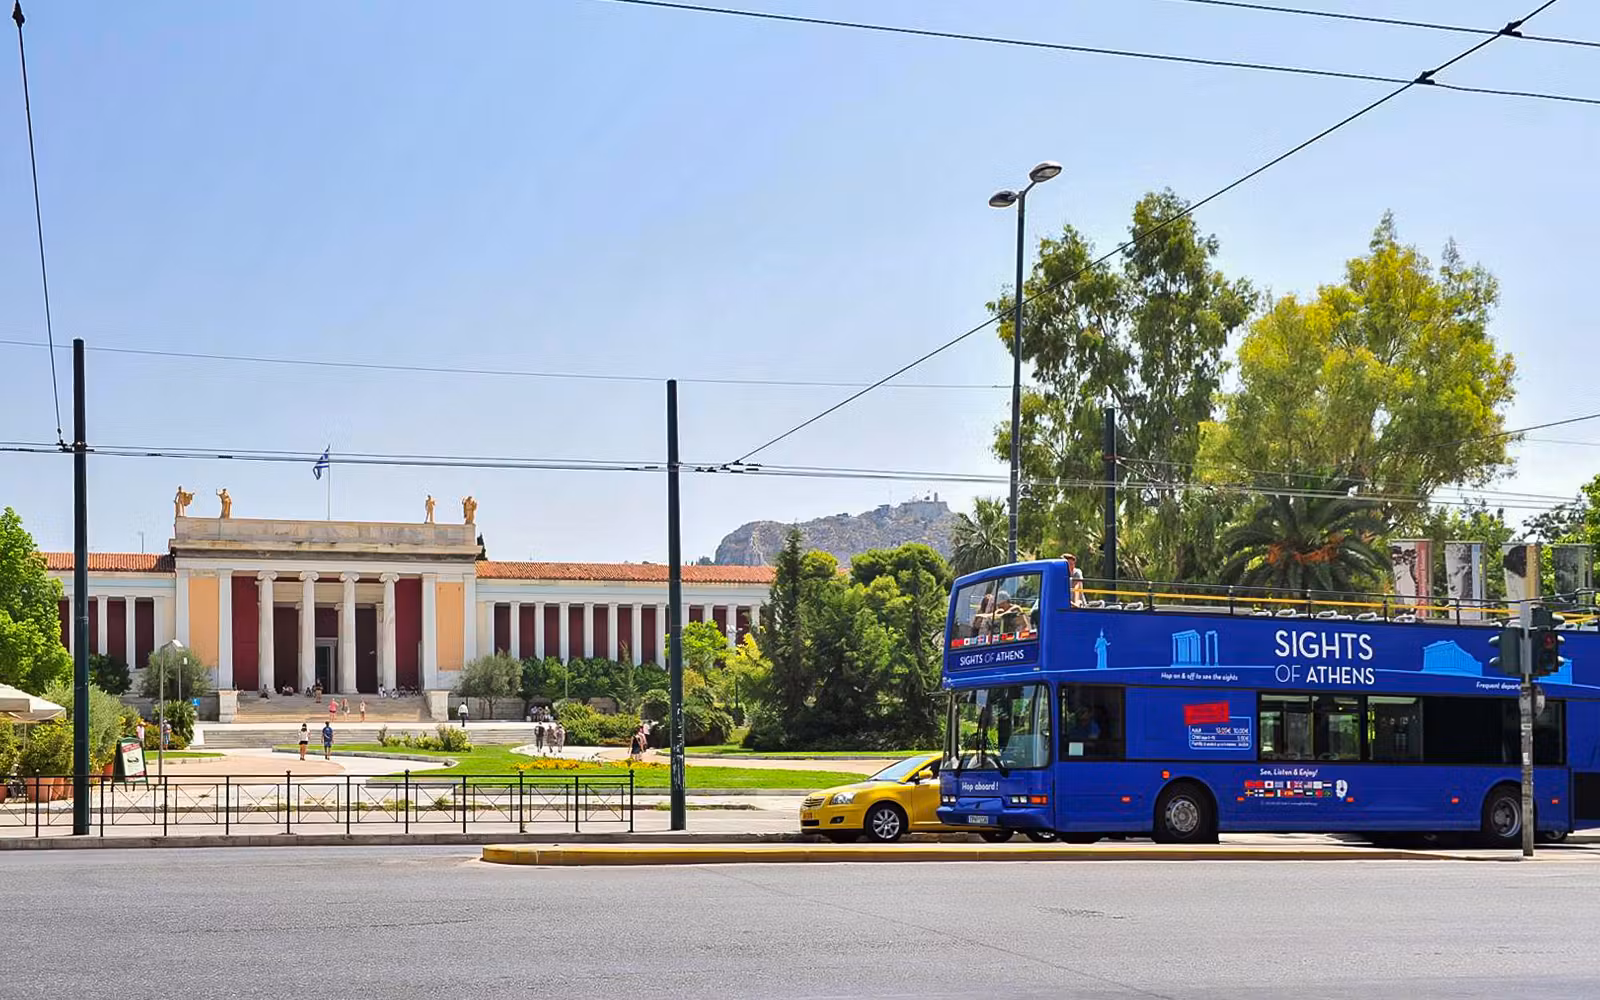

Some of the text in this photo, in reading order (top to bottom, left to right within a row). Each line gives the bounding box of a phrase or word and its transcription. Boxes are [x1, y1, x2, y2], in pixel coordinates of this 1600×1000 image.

[1275, 629, 1373, 660] SIGHTS
[960, 649, 1024, 666] SIGHTS OF ATHENS
[1275, 664, 1375, 685] OF ATHENS
[962, 781, 973, 792] Hop
